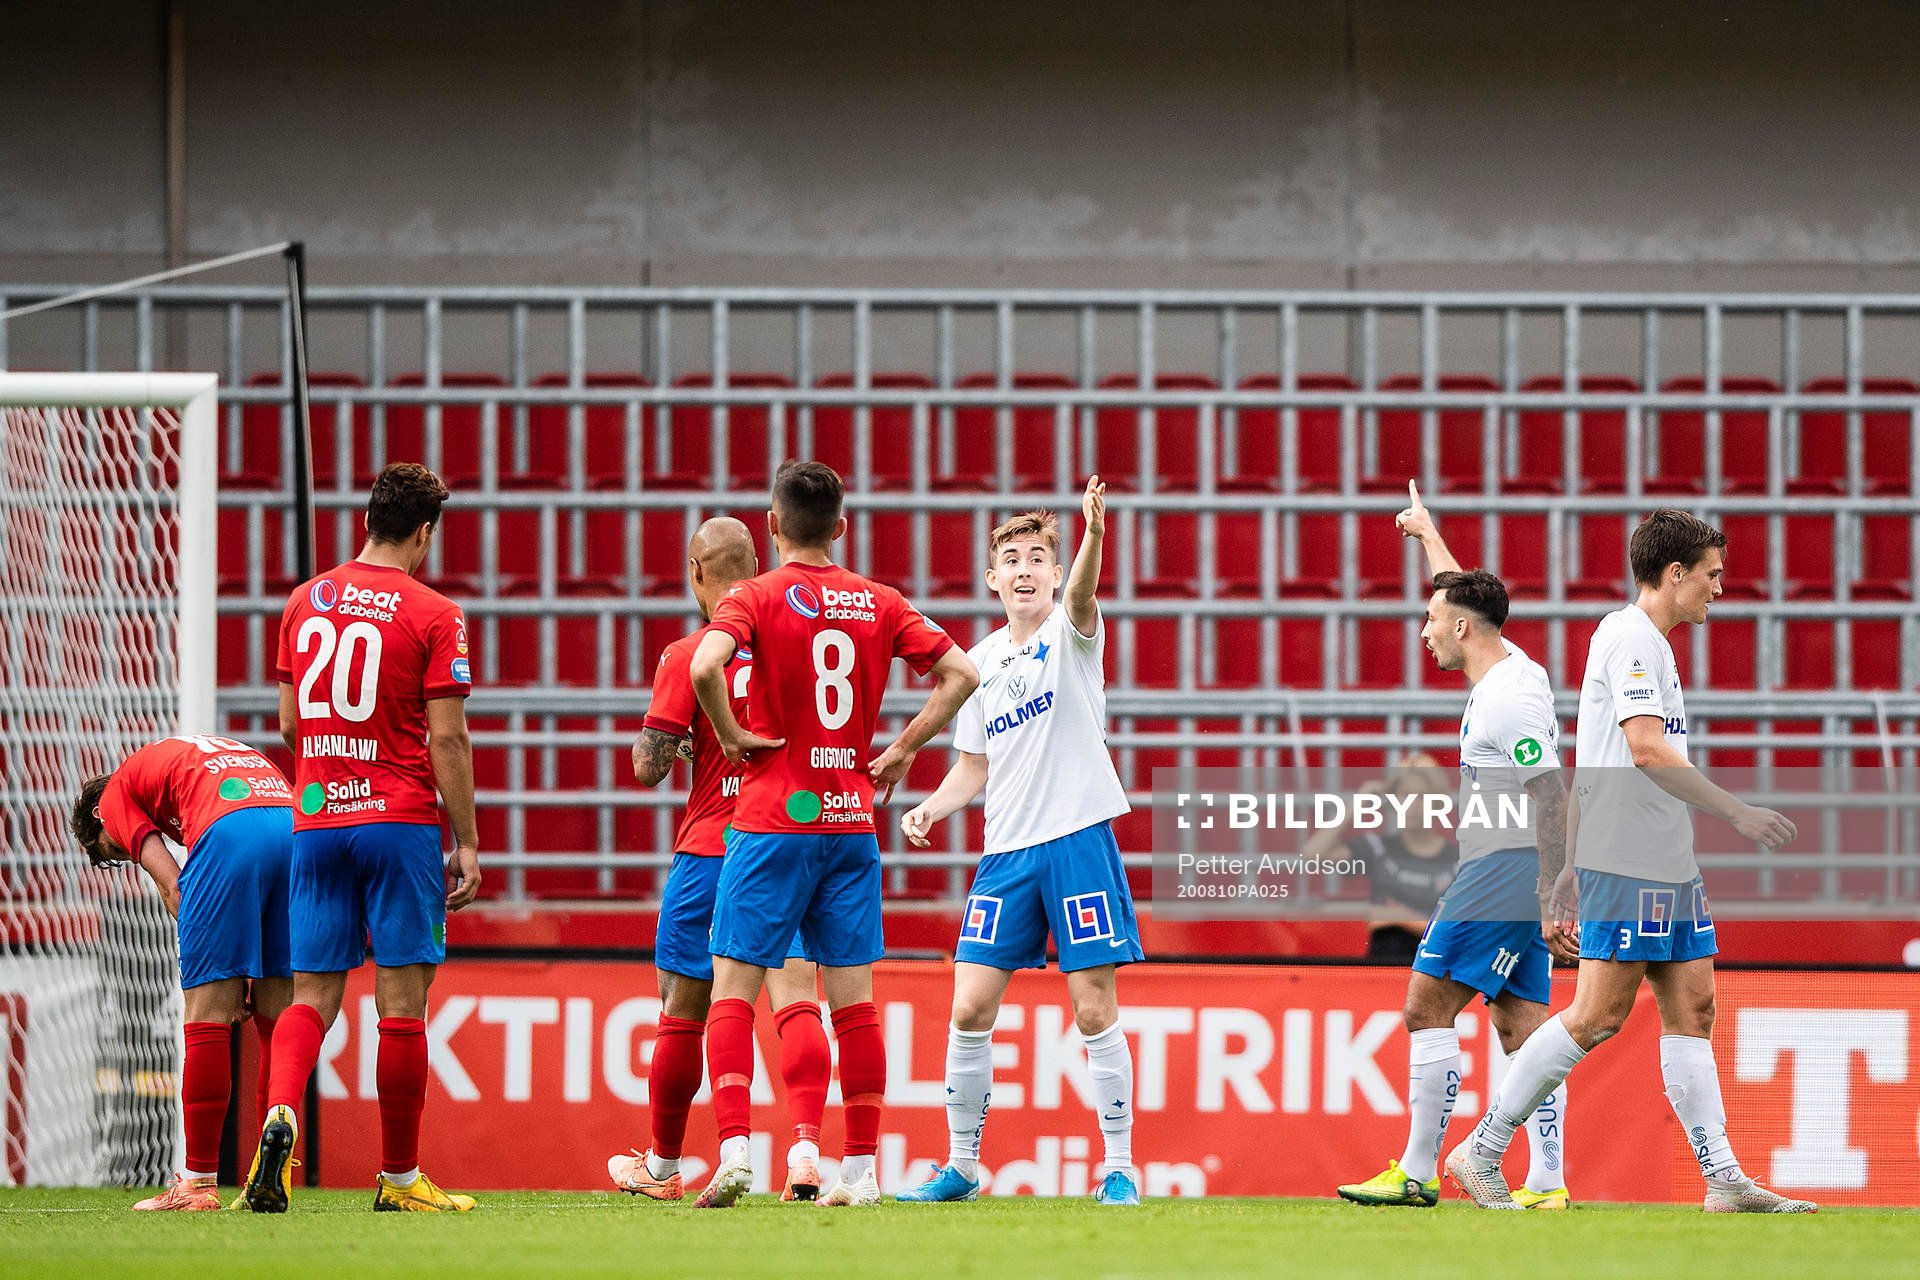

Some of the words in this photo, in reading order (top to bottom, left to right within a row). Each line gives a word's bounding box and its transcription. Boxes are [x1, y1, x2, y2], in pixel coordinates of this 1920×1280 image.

[341, 582, 402, 612] beat
[821, 585, 876, 609] beat
[337, 602, 394, 623] diabetes
[824, 607, 876, 622] diabetes
[296, 616, 383, 723] 20
[812, 629, 856, 731] 8
[1623, 688, 1655, 697] UNIBET
[810, 746, 857, 769] GIGOVIC
[247, 777, 289, 793] Solid
[326, 778, 371, 800] Solid
[327, 799, 387, 815] Försäkring
[823, 791, 862, 809] Solid
[822, 810, 874, 824] Försäkring
[1619, 928, 1632, 949] 3
